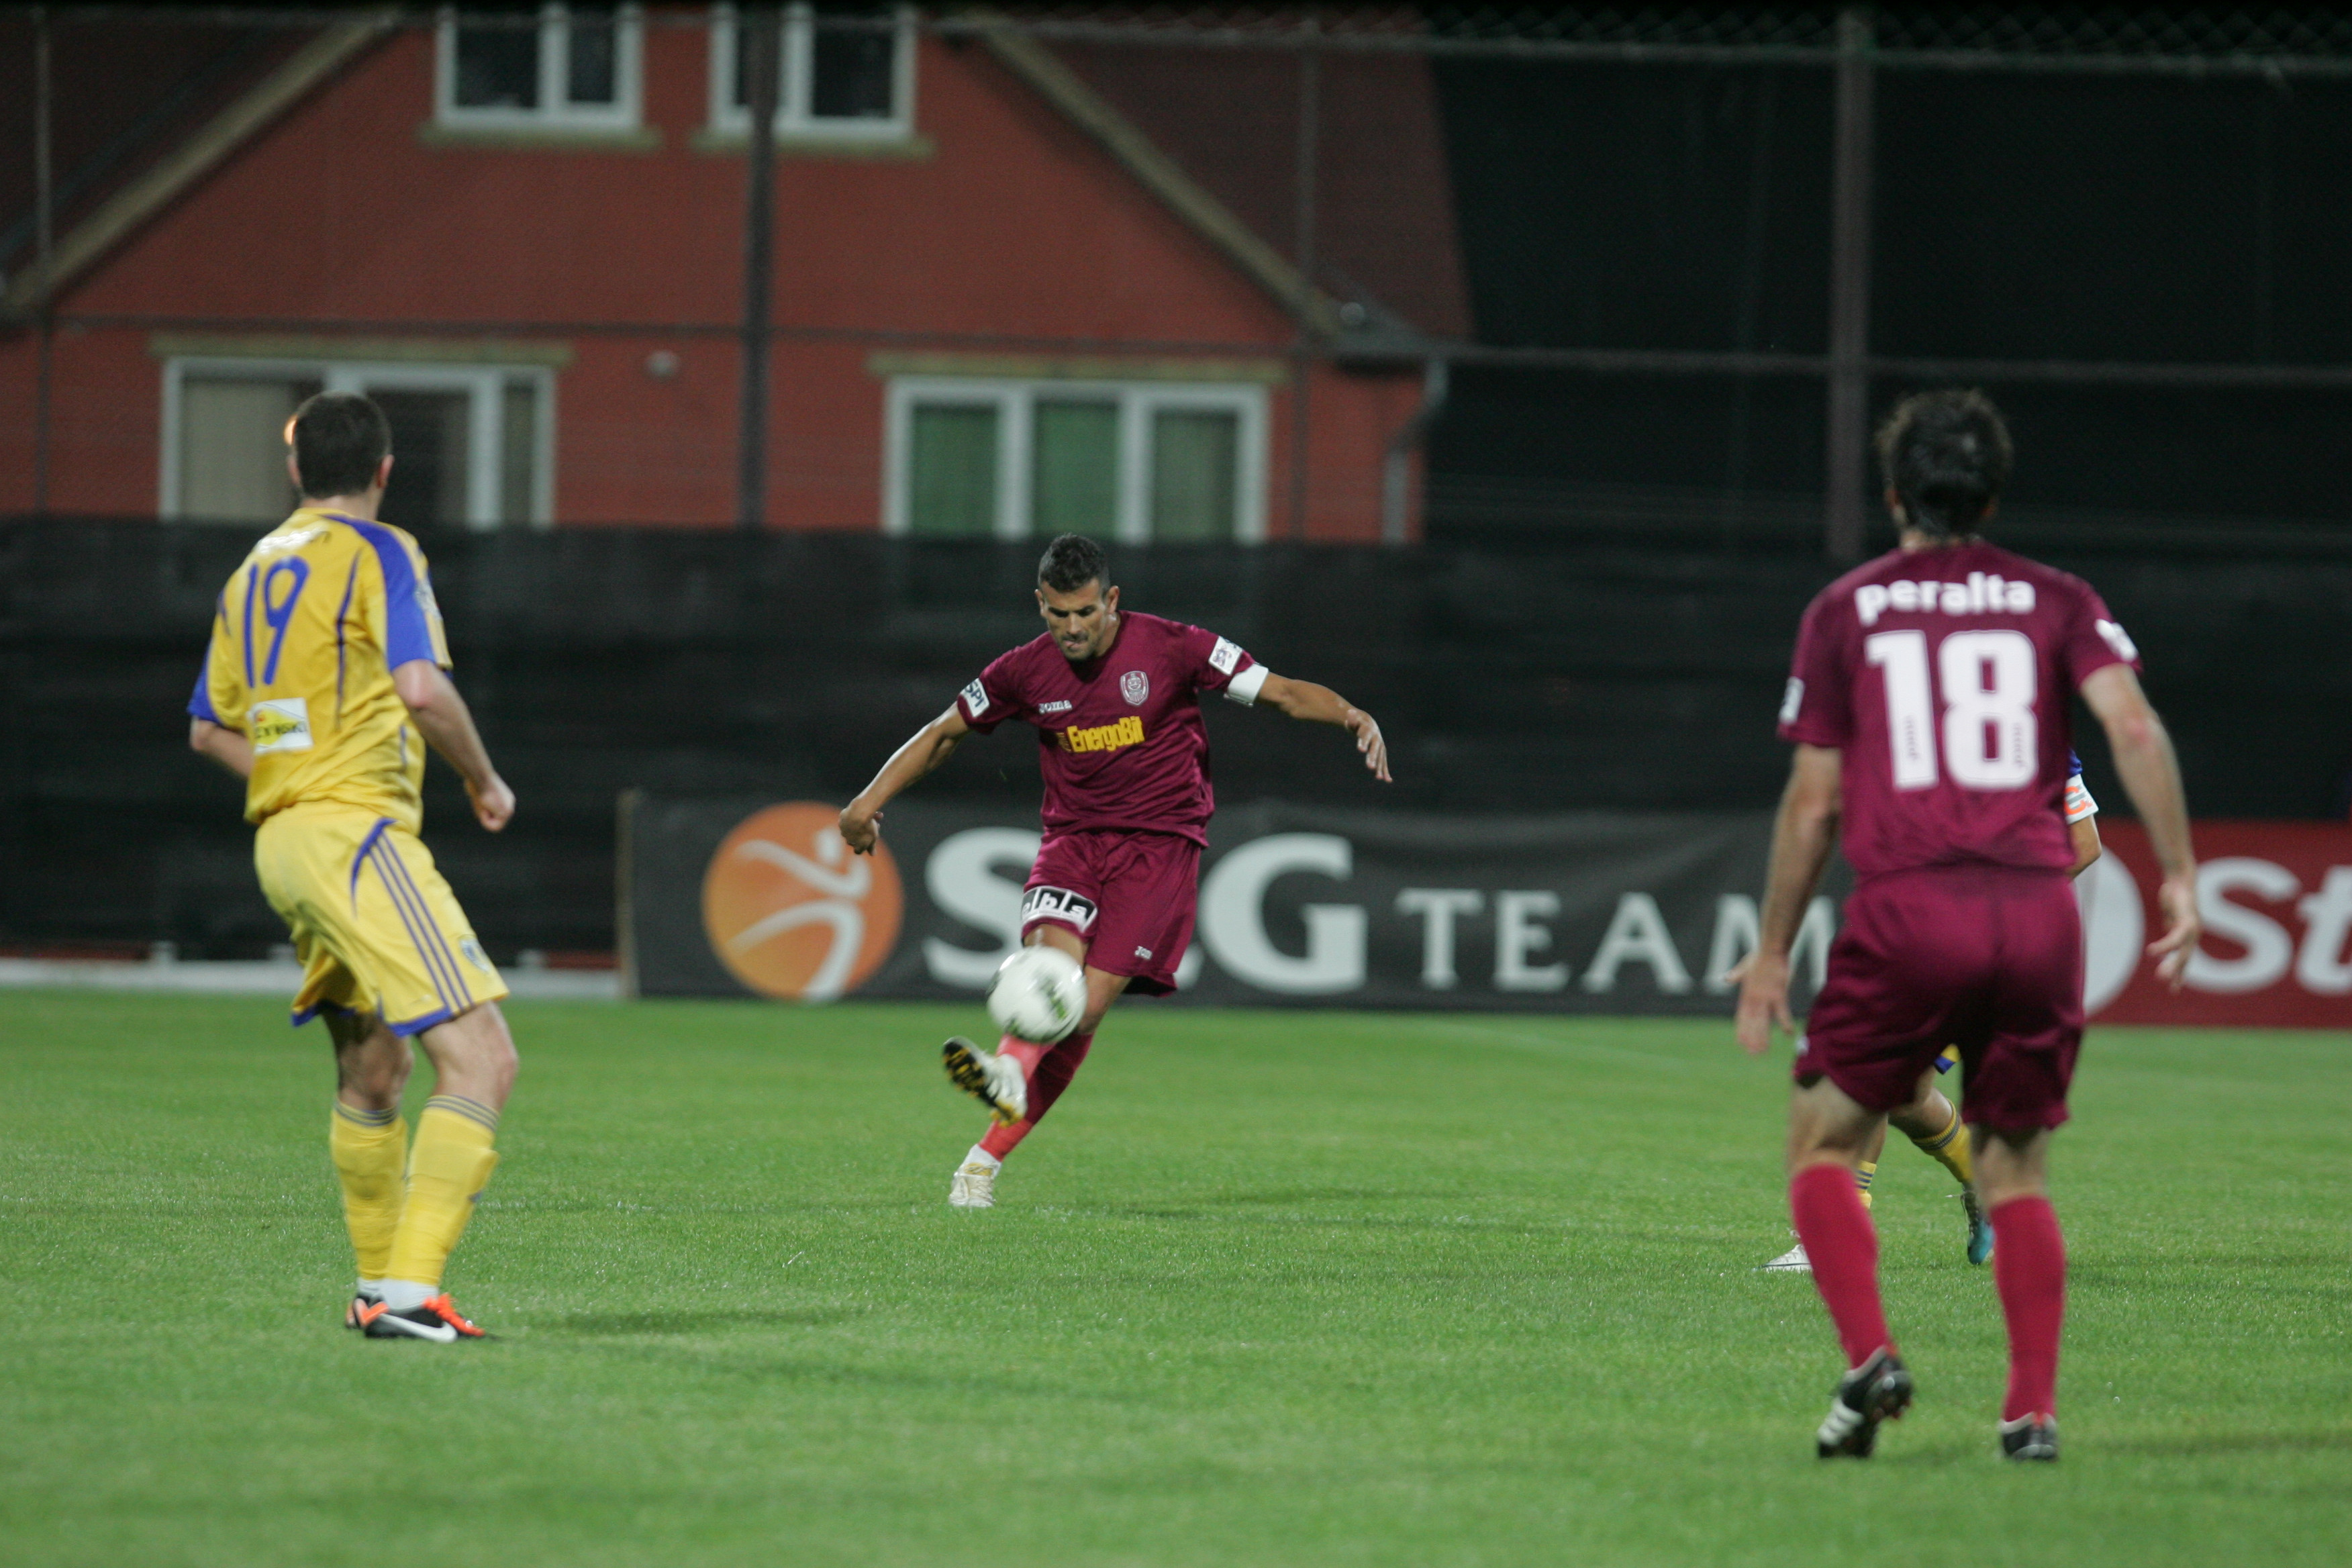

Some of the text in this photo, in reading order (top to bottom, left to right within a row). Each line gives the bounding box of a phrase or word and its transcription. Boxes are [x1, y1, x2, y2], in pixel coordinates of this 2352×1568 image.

[242, 555, 309, 689] 19
[1855, 571, 2036, 626] peralta
[1067, 716, 1145, 753] EnergoBit
[1863, 628, 2040, 791] 18
[923, 827, 1368, 995] SG
